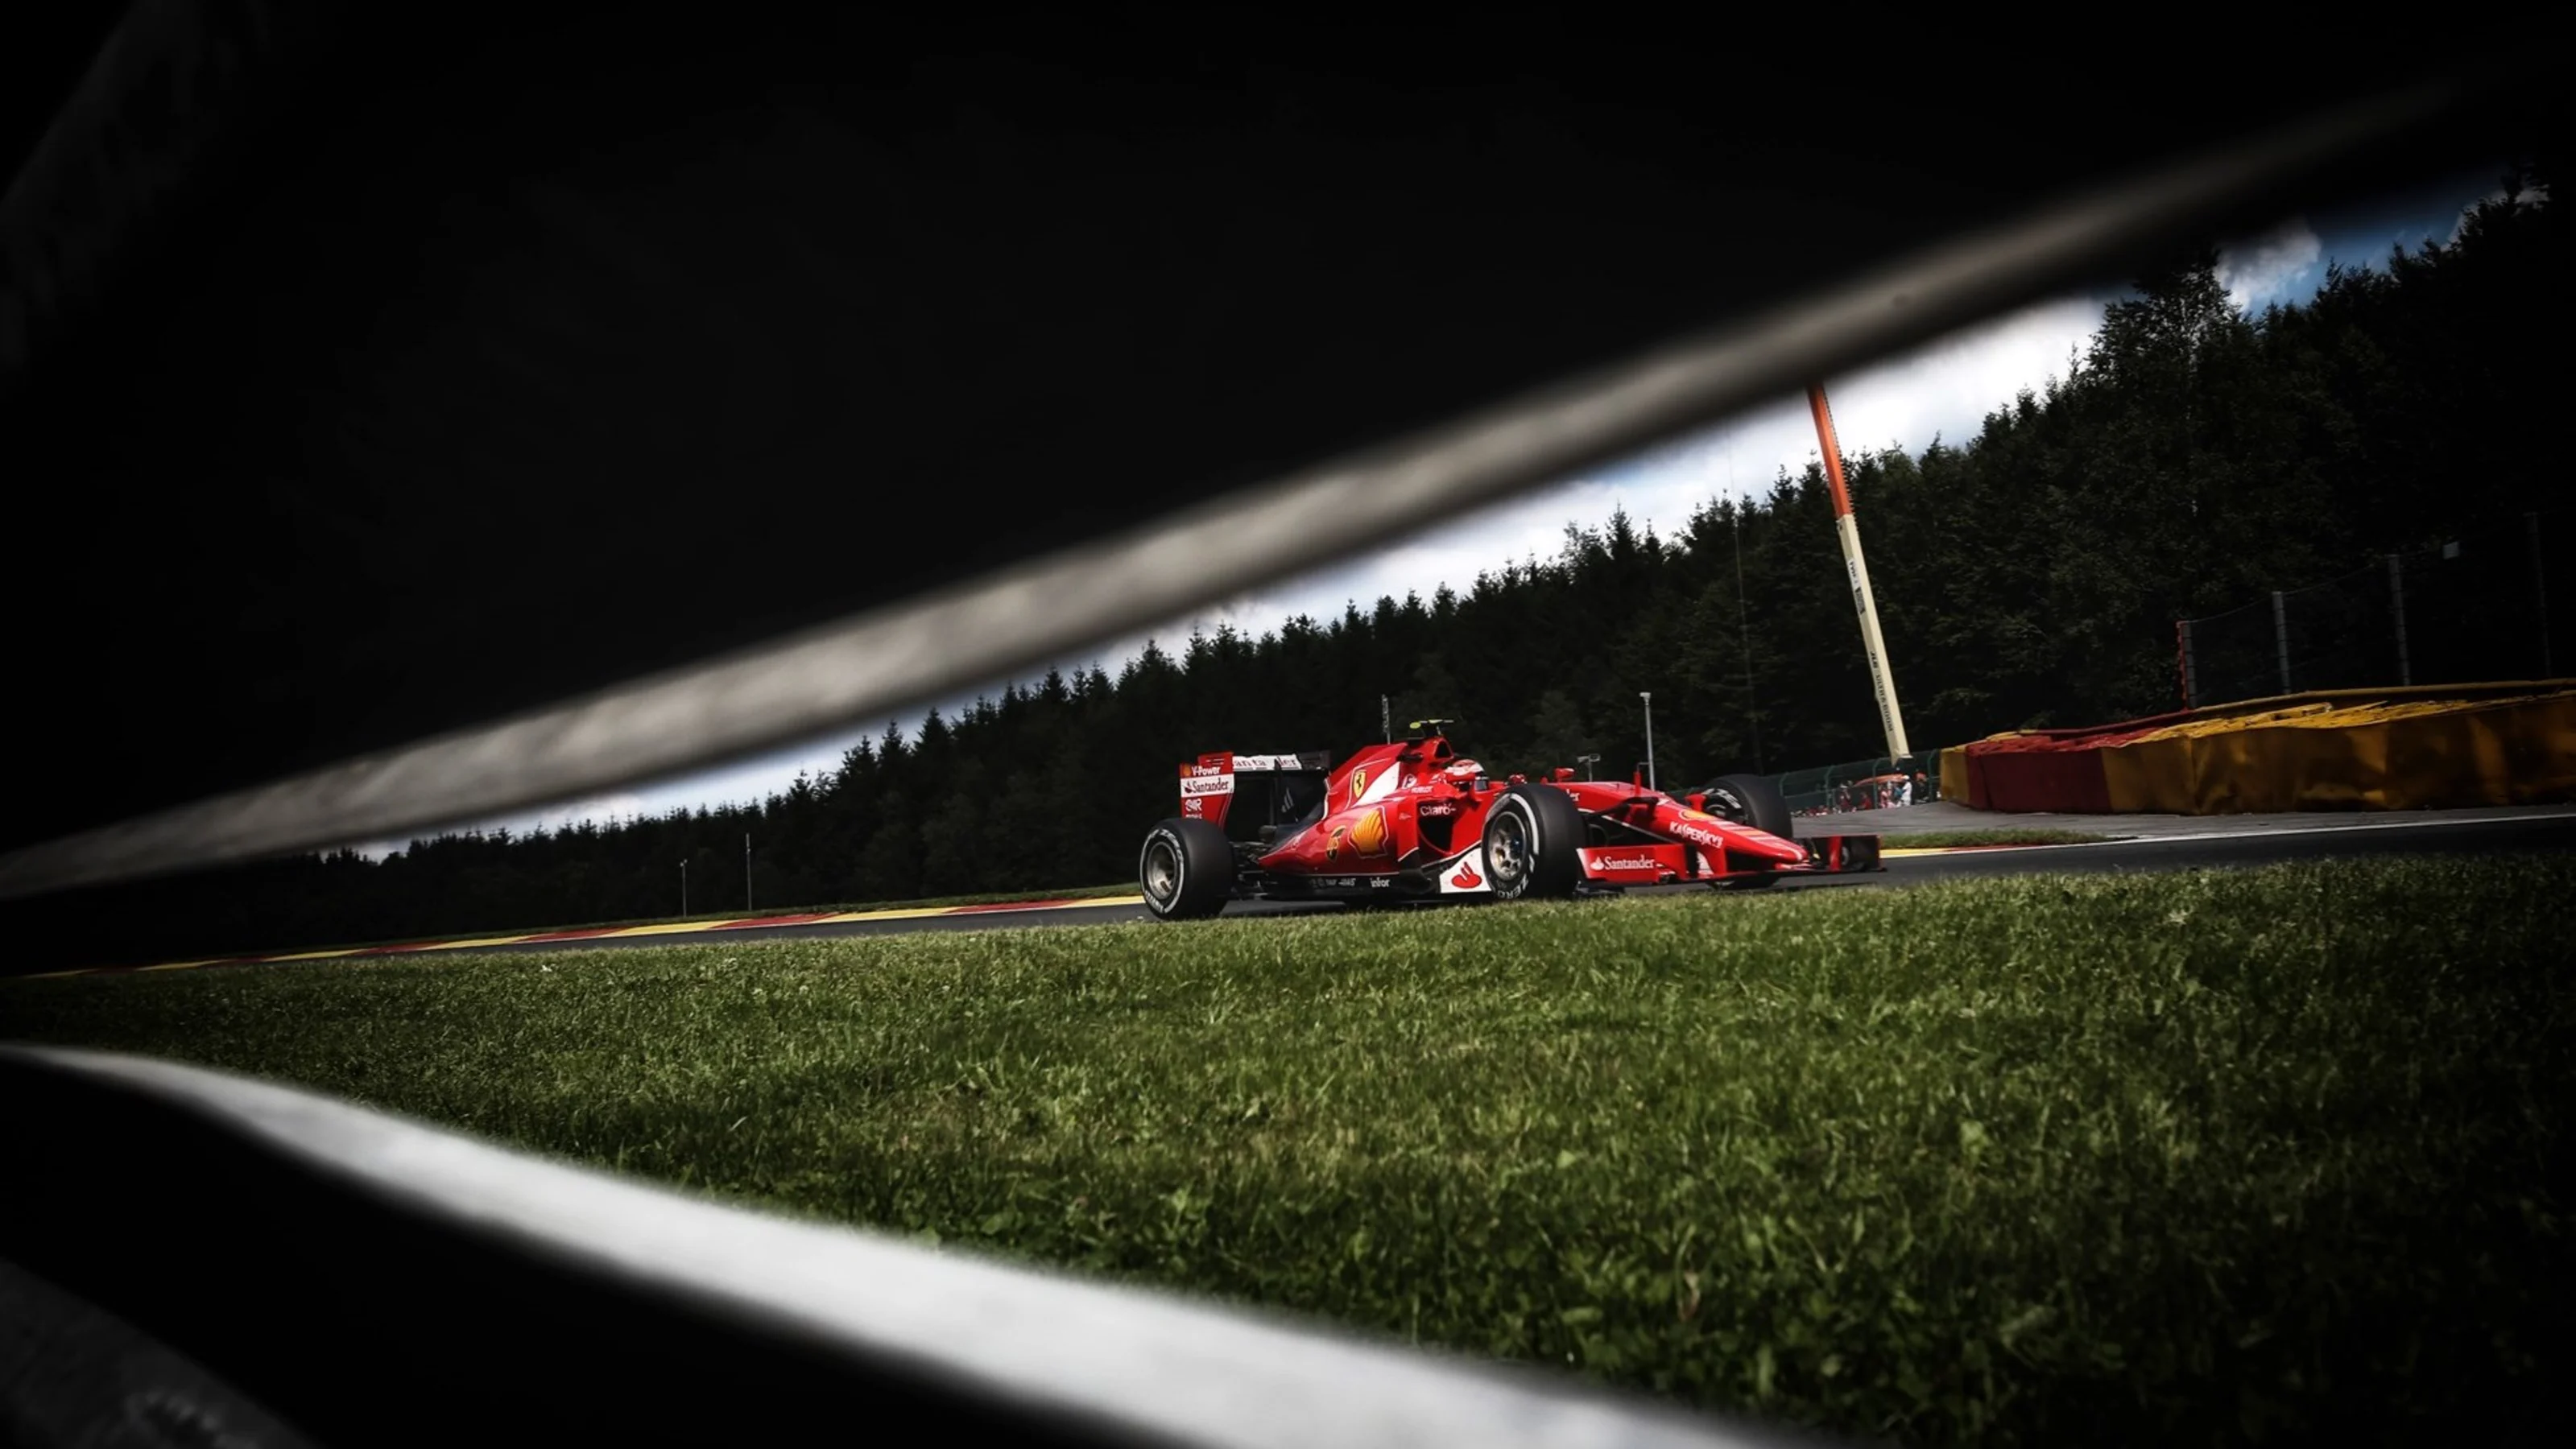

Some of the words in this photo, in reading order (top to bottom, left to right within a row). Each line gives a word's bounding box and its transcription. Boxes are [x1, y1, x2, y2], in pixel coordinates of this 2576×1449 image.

[1192, 766, 1221, 776] V-Power
[1193, 777, 1229, 793] Santander
[1420, 805, 1451, 816] Claro
[1669, 821, 1719, 848] KASPERSKY
[1604, 854, 1655, 870] Santander
